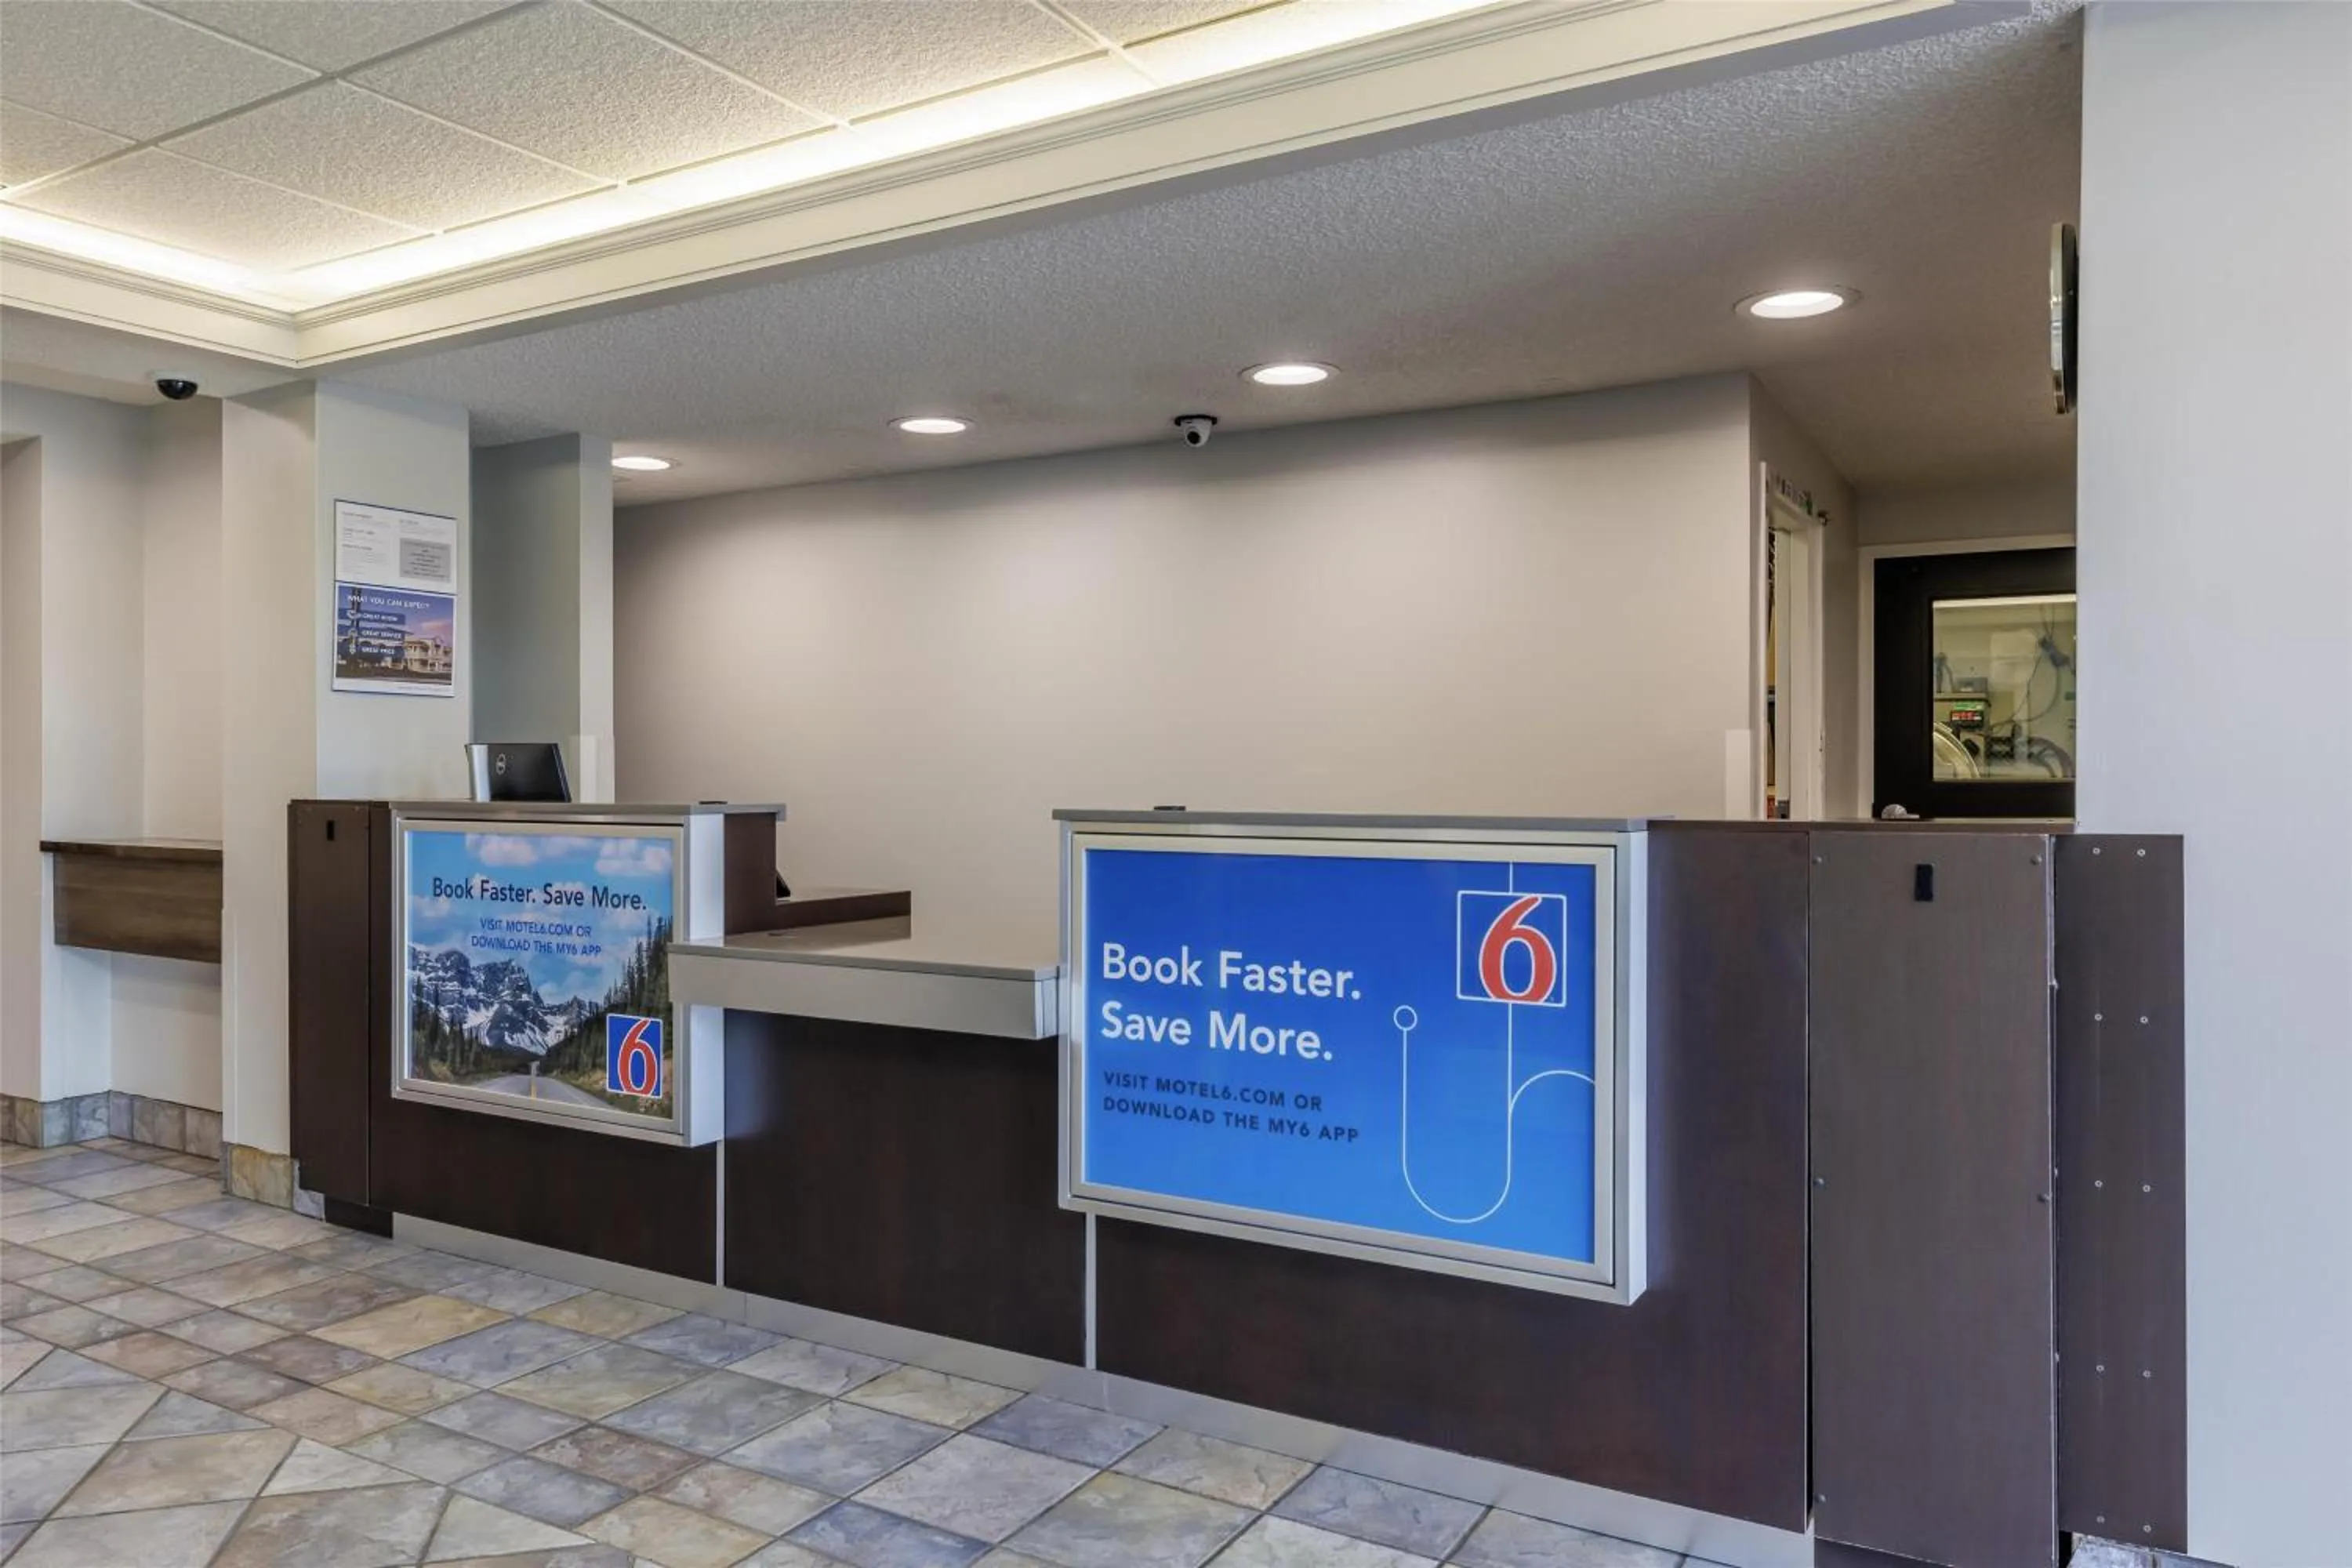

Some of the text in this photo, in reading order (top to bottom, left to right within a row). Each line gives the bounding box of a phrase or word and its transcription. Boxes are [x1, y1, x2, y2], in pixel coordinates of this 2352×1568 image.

[432, 877, 647, 910] Book Faster. Save More.
[471, 935, 601, 957] DOWNLOAD THE MY6 APP
[480, 917, 592, 938] VISIT MOTEL6.COM OR
[1479, 894, 1557, 1004] 6
[1102, 942, 1361, 1000] Book Faster.
[1101, 1000, 1333, 1061] Save More.
[617, 1018, 658, 1097] 6
[1103, 1071, 1323, 1112] VISIT MOTEL6.COM OR
[1102, 1096, 1359, 1143] DOWNLOAD THE MY6 APP
